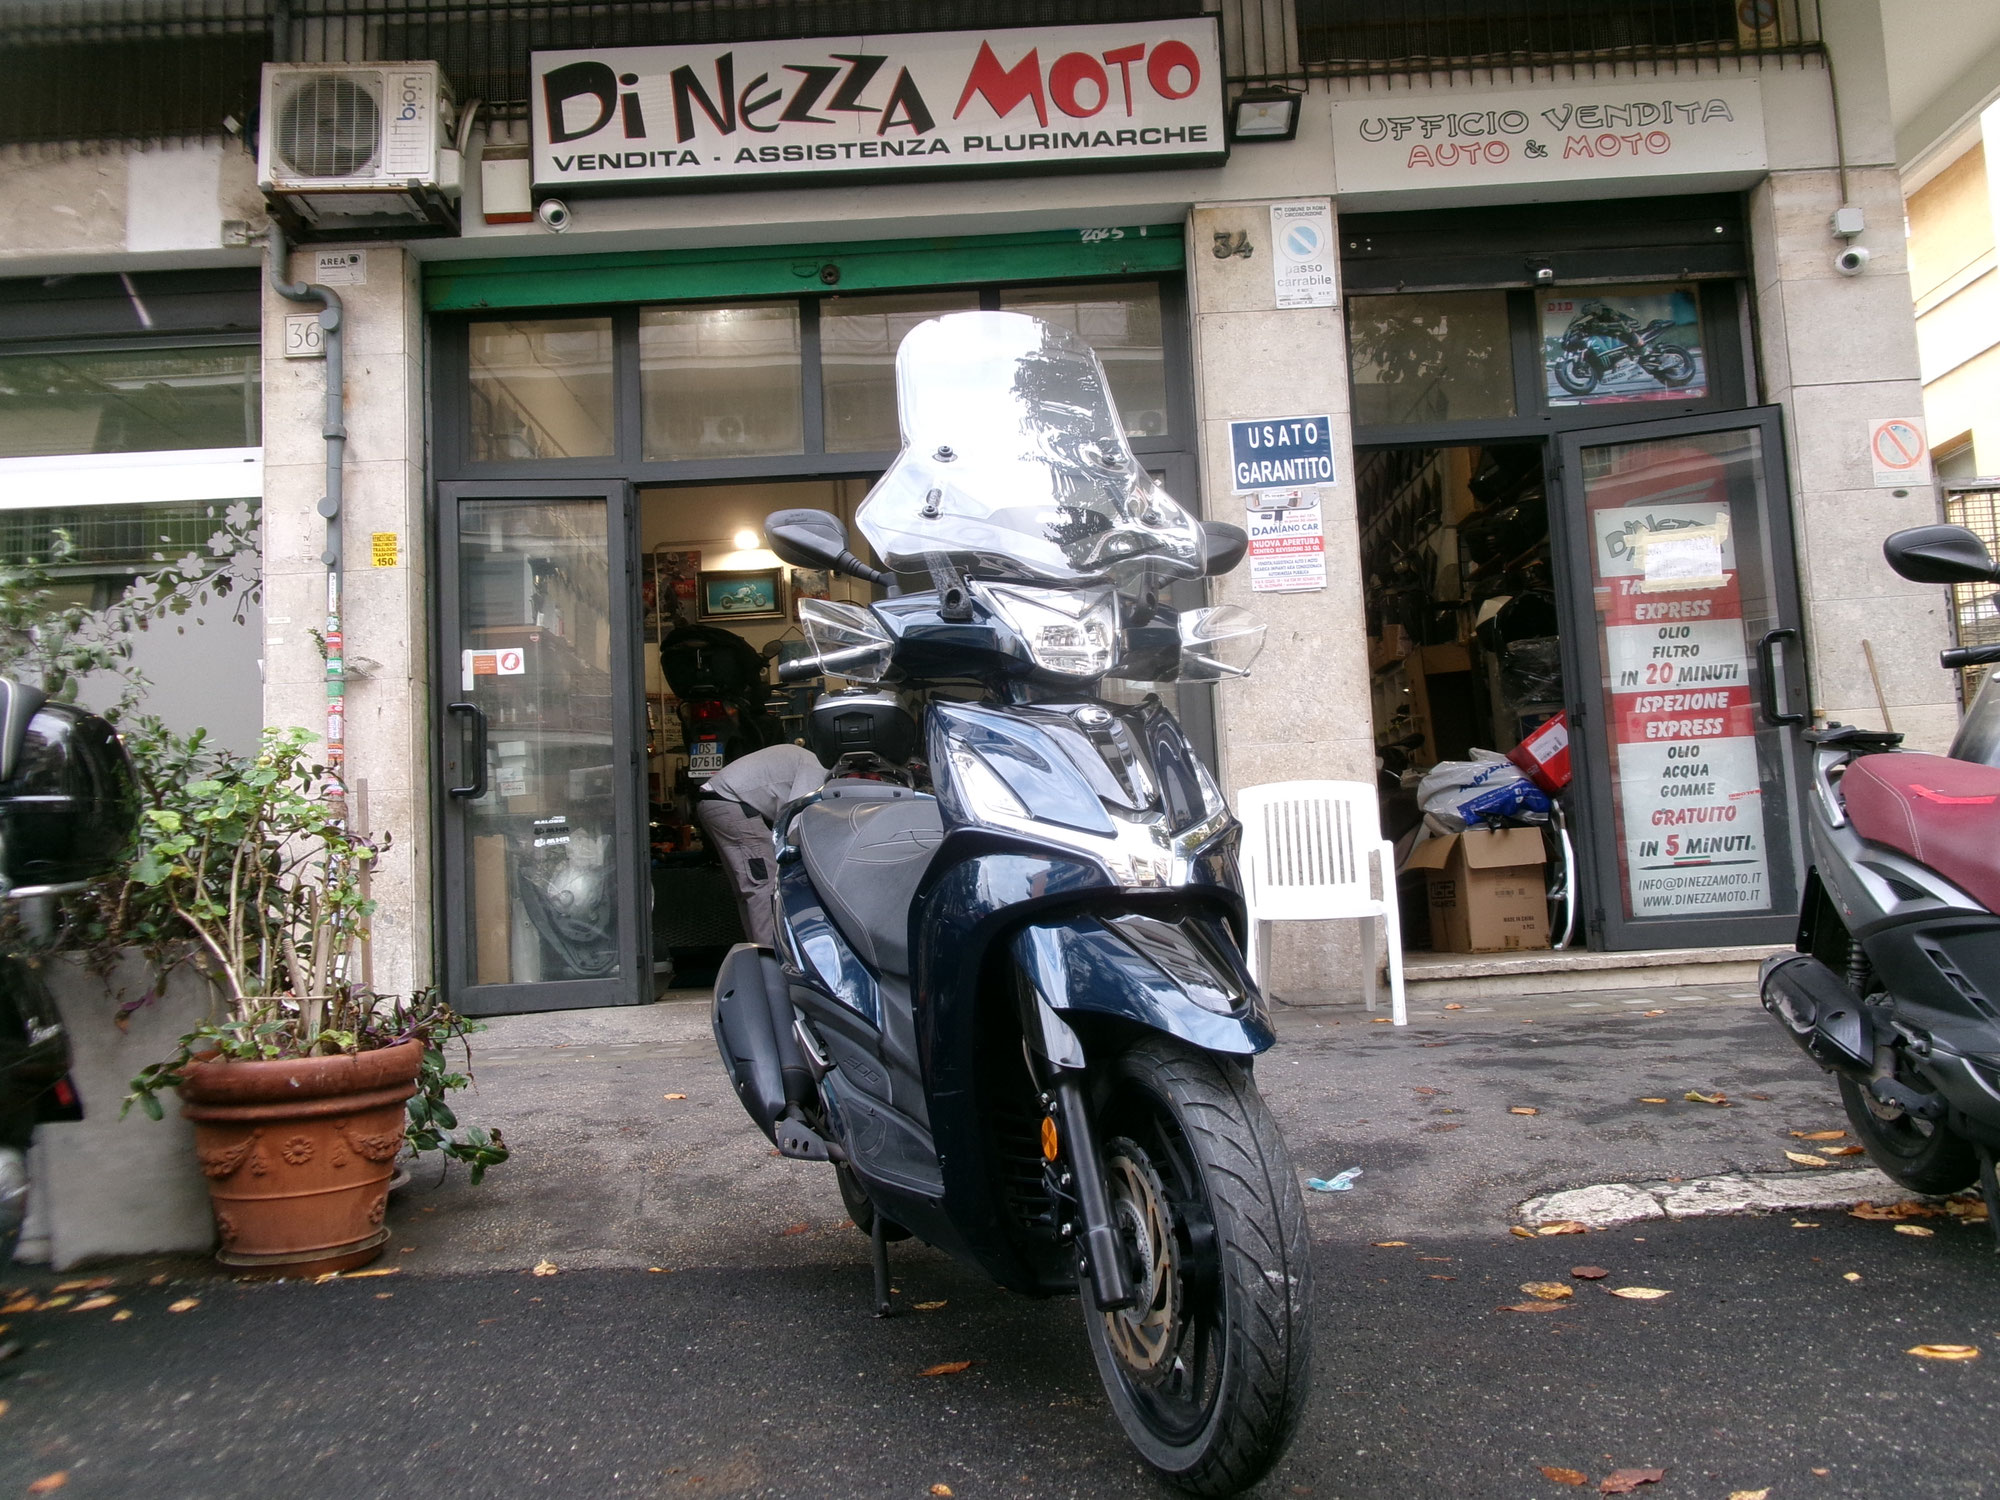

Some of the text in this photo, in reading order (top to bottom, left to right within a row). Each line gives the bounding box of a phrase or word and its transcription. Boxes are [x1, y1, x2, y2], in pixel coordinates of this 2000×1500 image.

[953, 38, 1201, 128] MOTO
[396, 76, 417, 121] bion
[1359, 98, 1735, 142] UFFICIO VENDITA
[552, 148, 702, 172] VENDITA
[733, 137, 948, 165] ASSISTENZA
[963, 124, 1208, 153] PLURIMARCHE
[1407, 130, 1671, 168] AUTO & MOTO
[1212, 230, 1254, 259] 34
[320, 257, 346, 266] AREA
[1285, 264, 1323, 277] passo
[1277, 275, 1332, 287] carrabile
[288, 321, 320, 350] 36
[1248, 422, 1318, 449] USATO
[1237, 456, 1331, 484] GARANTITO
[1252, 523, 1300, 537] DAMIANO
[1302, 523, 1319, 531] CAR
[1252, 537, 1320, 548] NUOVA APERTURA
[1635, 599, 1712, 620] EXPRESS
[1658, 626, 1690, 639] OLIO
[1652, 644, 1699, 659] FILTRO
[1621, 662, 1738, 686] IN 20 MINUTI
[1634, 691, 1729, 714] ISPEZIONE
[1646, 718, 1724, 738] EXPRESS
[1667, 745, 1700, 759] OLIO
[691, 756, 722, 769] 07618
[1662, 763, 1710, 779] ACQUA
[1660, 782, 1715, 798] GOMME
[1651, 805, 1737, 826] GRATUITO
[1639, 841, 1659, 857] IN
[1665, 834, 1680, 856] 5
[1638, 872, 1763, 891] INFO@DINEZZAMOTO.IT
[1643, 889, 1761, 907] WWW.DINEZZAMOTO.IT
